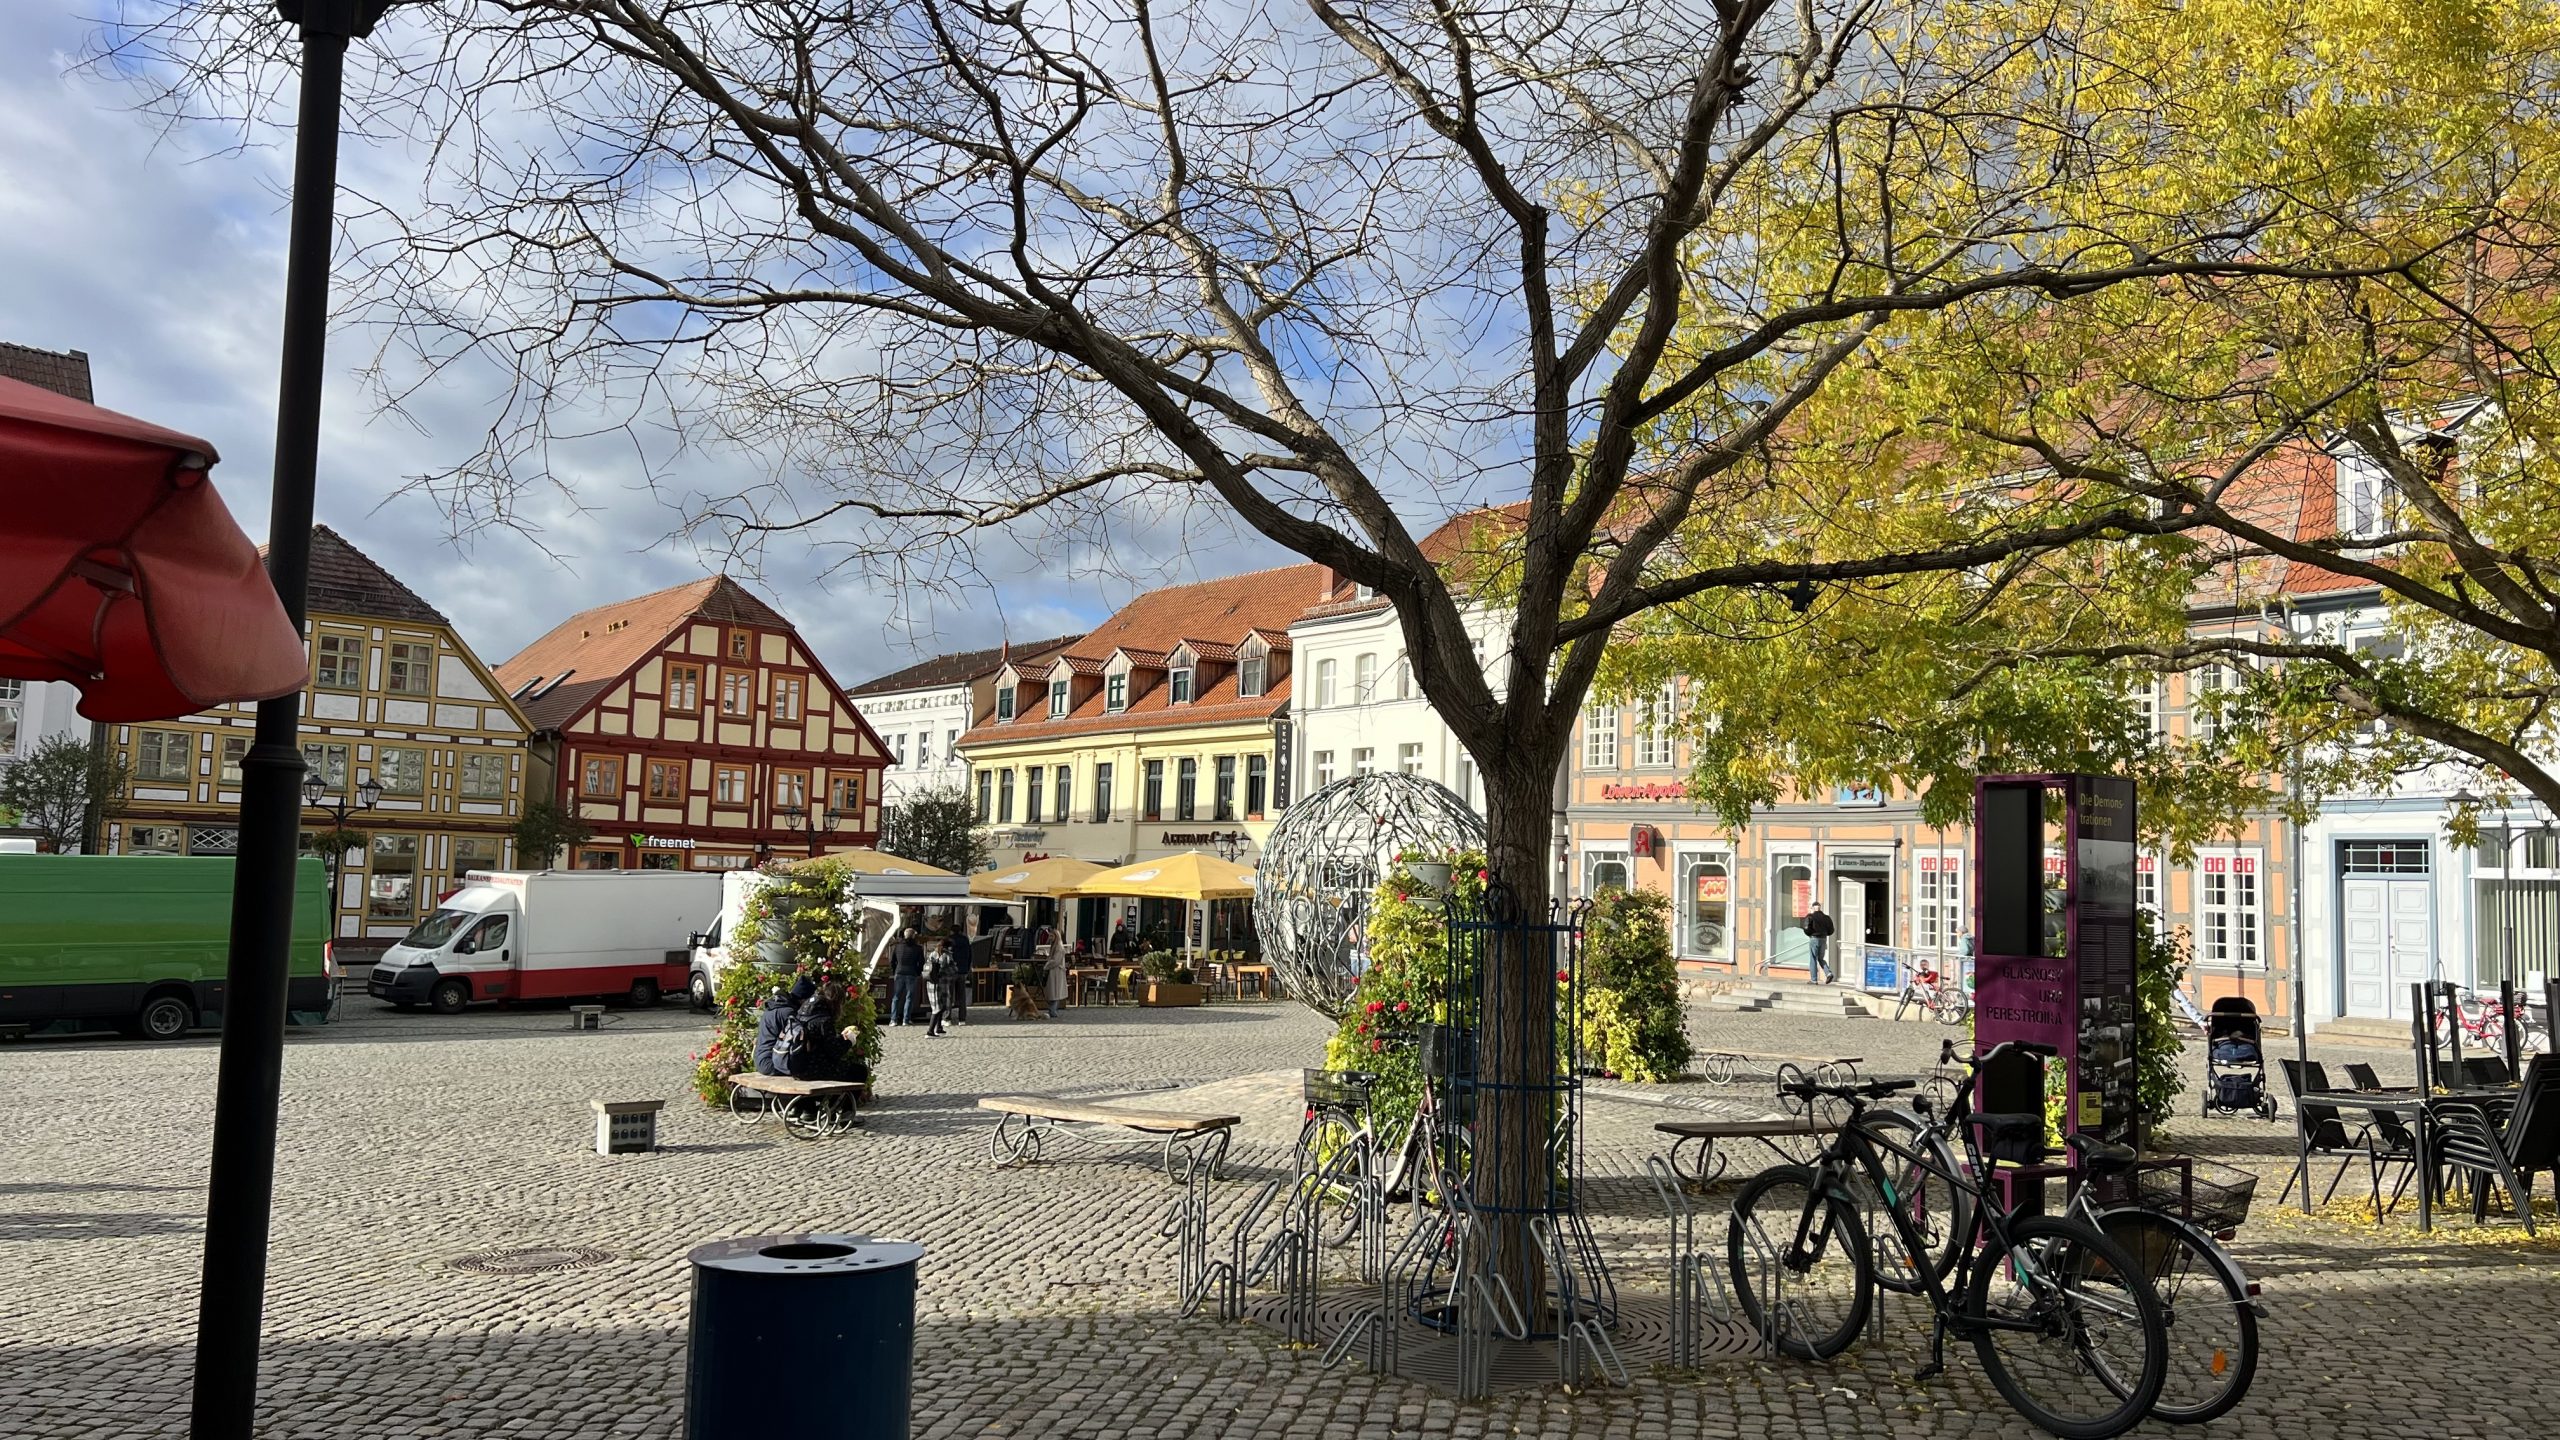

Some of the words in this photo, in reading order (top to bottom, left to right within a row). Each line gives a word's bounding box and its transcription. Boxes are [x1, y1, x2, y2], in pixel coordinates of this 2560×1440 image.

[1601, 782, 1690, 802] Löwen-Apothe
[2080, 793, 2093, 807] Die
[2093, 794, 2126, 809] Demons-
[2080, 813, 2112, 827] trationen
[648, 835, 696, 849] freenet
[2039, 988, 2063, 1005] UND
[1985, 1005, 2063, 1025] PERESTROIKA
